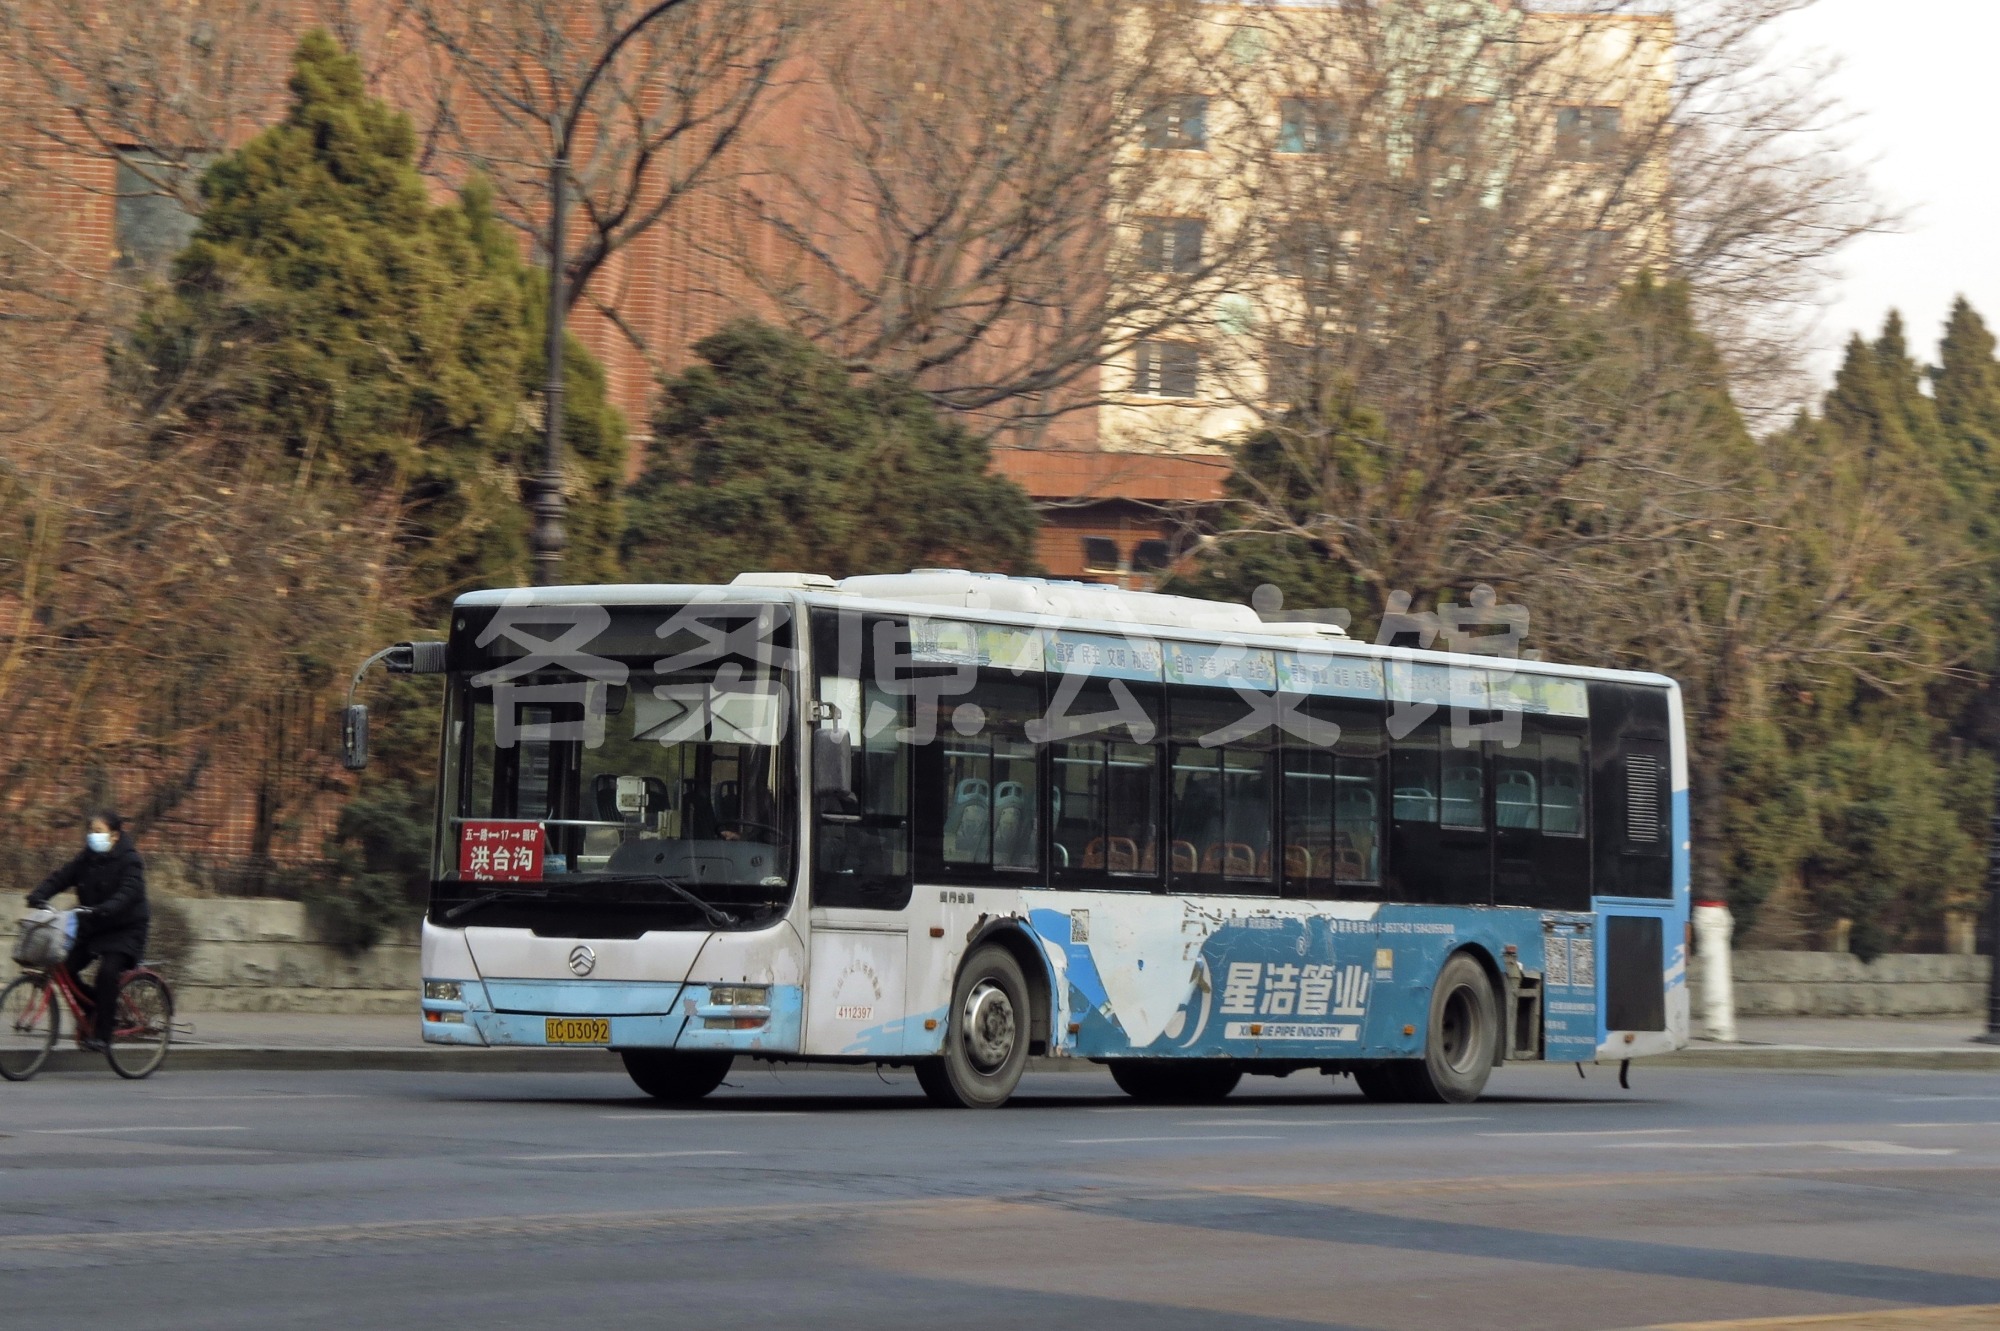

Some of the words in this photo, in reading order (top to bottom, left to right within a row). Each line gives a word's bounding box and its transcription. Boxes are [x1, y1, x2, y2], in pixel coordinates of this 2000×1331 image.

[1056, 643, 1075, 662] 富强
[1081, 645, 1101, 665] 民主
[1107, 648, 1126, 668] 文明
[1176, 655, 1193, 674] 自由
[1223, 658, 1240, 677] 公正
[501, 829, 509, 840] 17
[470, 845, 533, 871] 洪台沟
[1219, 962, 1370, 1016] 星洁管业
[839, 1007, 872, 1019] 4112397
[1275, 1026, 1297, 1036] PIPE
[1297, 1026, 1343, 1038] INDUSTRY
